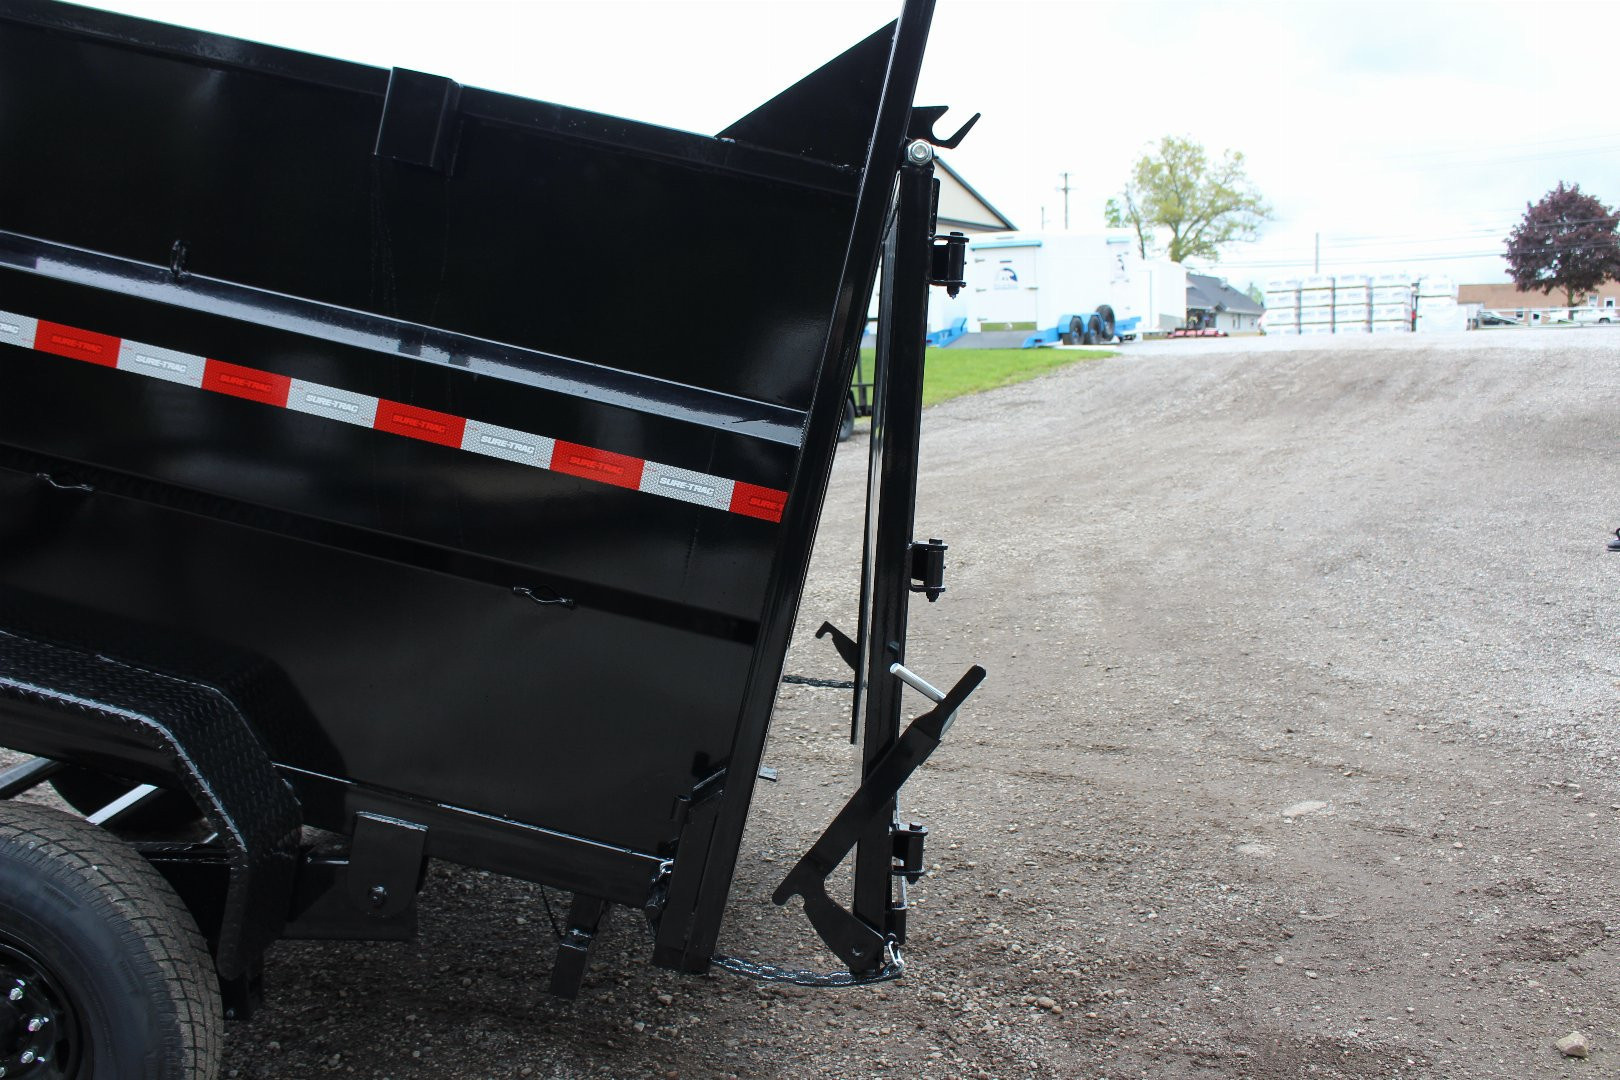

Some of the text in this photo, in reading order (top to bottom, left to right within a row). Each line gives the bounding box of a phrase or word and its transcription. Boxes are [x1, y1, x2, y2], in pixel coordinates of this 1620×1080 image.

[135, 355, 187, 372] SURE-TRAC
[219, 374, 273, 392] SURE-TRAC
[305, 395, 358, 413] SURE-TRAC
[481, 436, 535, 454] SURE-TRAC
[660, 477, 715, 496] SURE-TRAC
